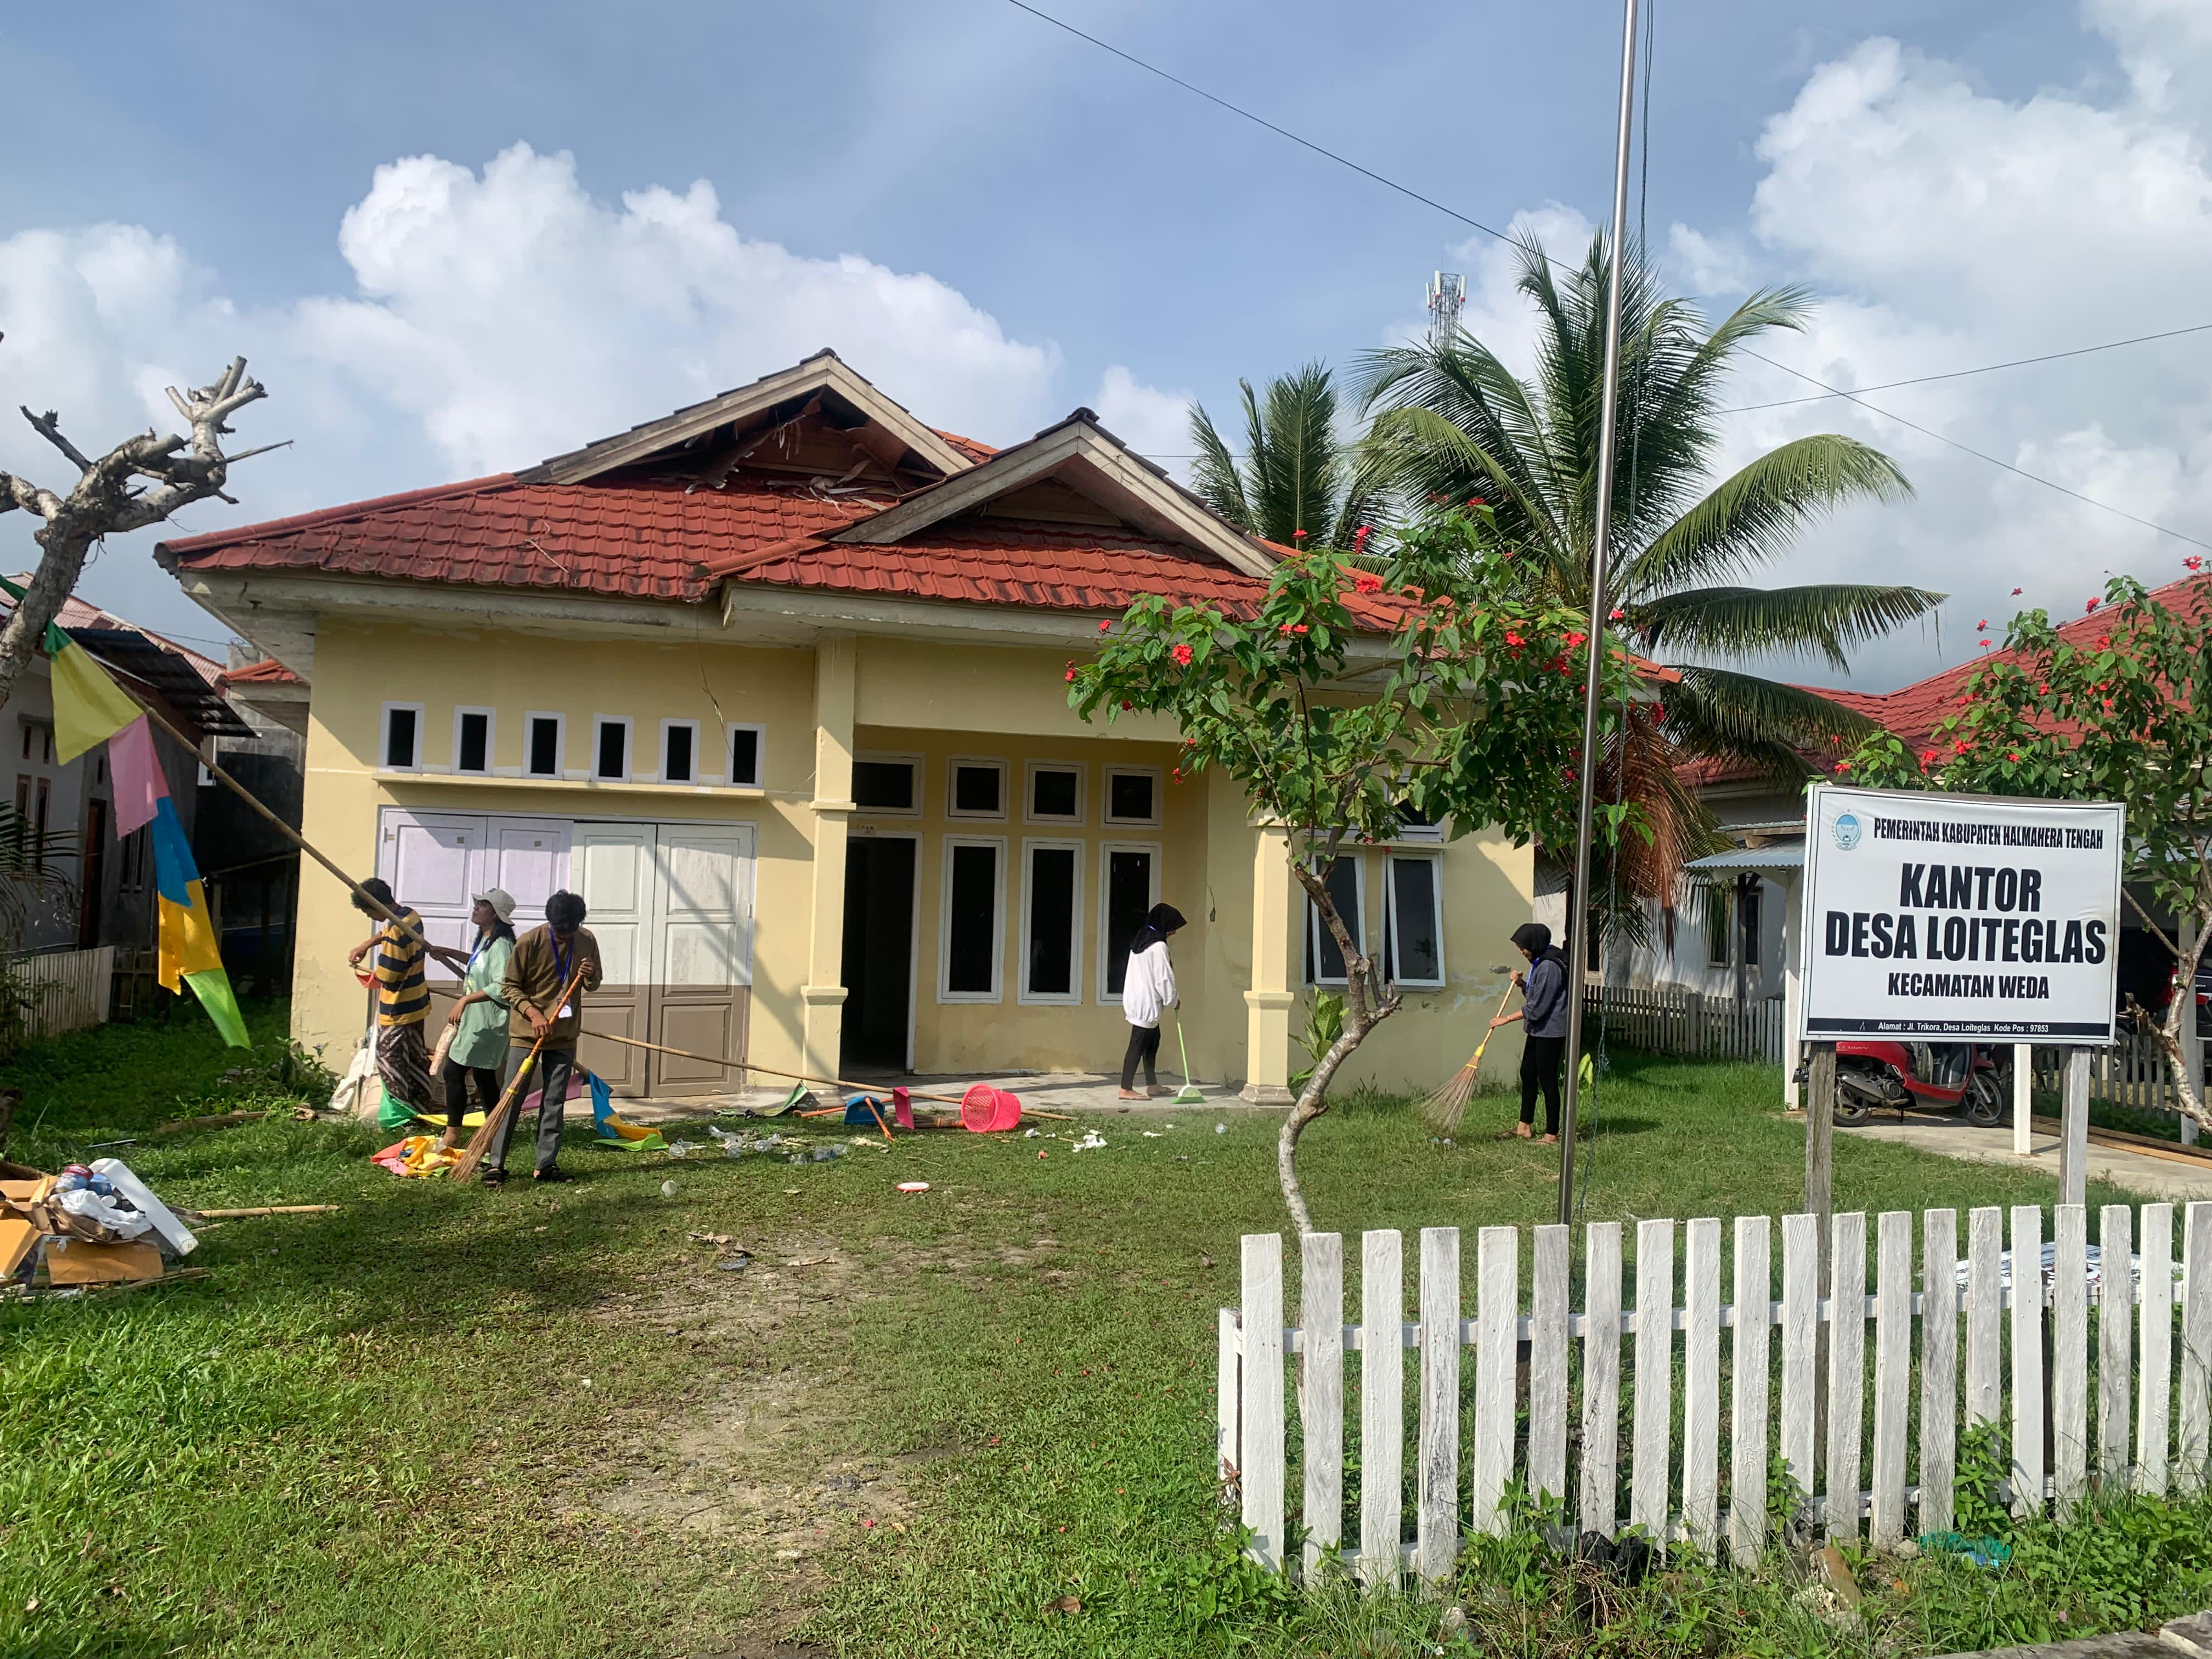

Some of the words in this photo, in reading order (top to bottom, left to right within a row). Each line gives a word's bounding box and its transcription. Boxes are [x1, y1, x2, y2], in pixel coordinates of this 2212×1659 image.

[1874, 817, 1940, 842] PEMERINTAH
[1942, 822, 2001, 845] KABUPATEN
[2003, 825, 2063, 848] HALMAHERA
[2065, 828, 2103, 849] TENGAH
[1900, 862, 2041, 912] KANTOR
[1825, 911, 1917, 959] DESA
[1926, 916, 2106, 964] LOITEGLAS
[1888, 972, 1994, 998] KECAMATAN
[1999, 975, 2049, 999] WEDA
[1878, 1022, 1901, 1030] Alamat
[1906, 1023, 1915, 1031] Jl.
[1917, 1022, 1942, 1032] Trikora,
[1943, 1023, 1960, 1031] Desa
[1961, 1024, 1991, 1033] Loiteglas
[1994, 1024, 2011, 1032] Kode
[2030, 1024, 2049, 1032] 97853
